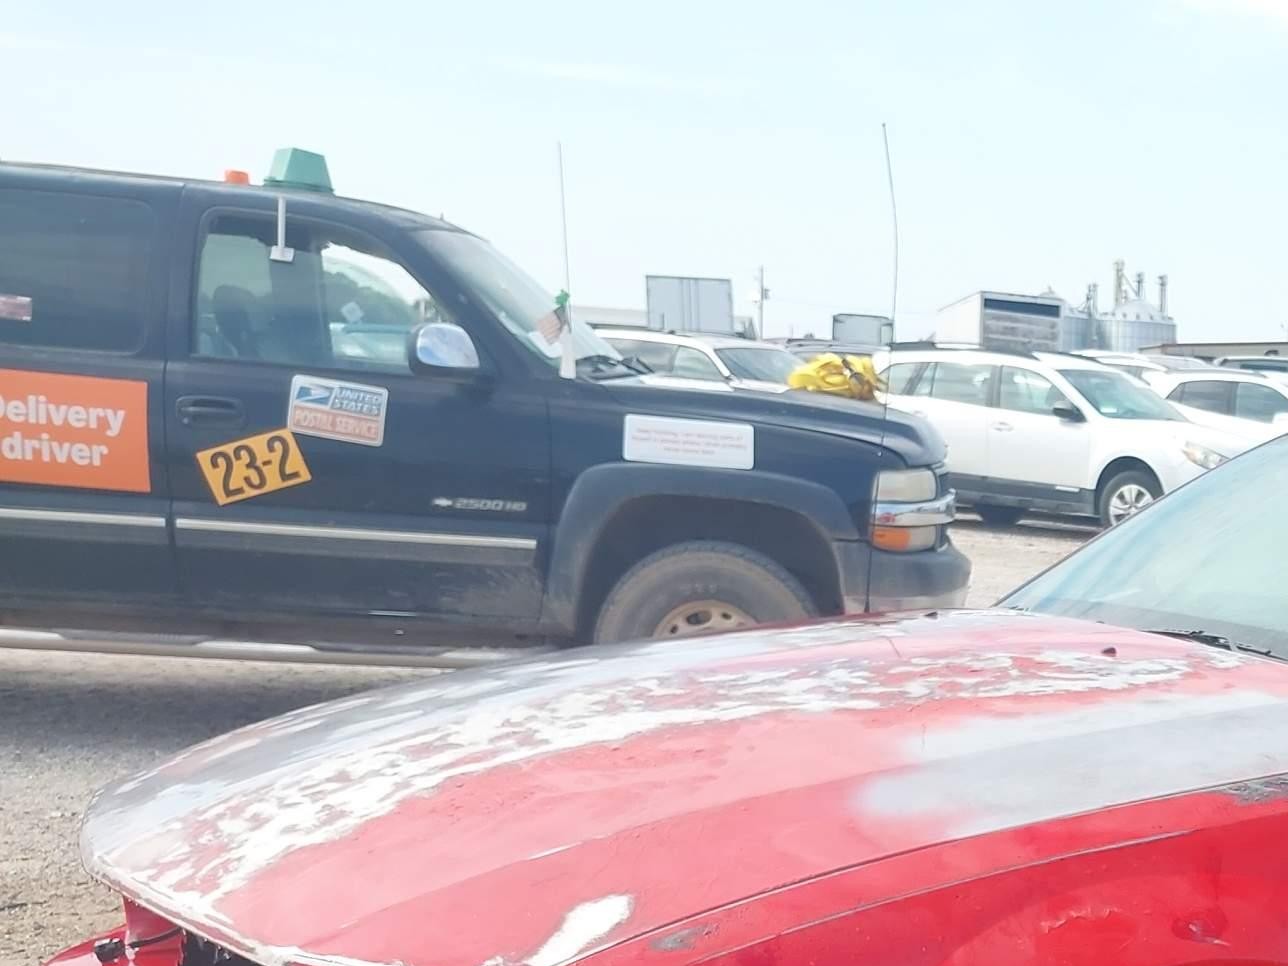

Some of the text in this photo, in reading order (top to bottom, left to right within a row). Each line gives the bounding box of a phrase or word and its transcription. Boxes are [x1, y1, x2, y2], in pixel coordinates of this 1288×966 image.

[334, 400, 380, 415] STATES
[335, 387, 381, 405] UNITED
[294, 409, 378, 438] POSTAL SERVICE
[2, 431, 109, 467] driver
[210, 435, 302, 499] 23-2
